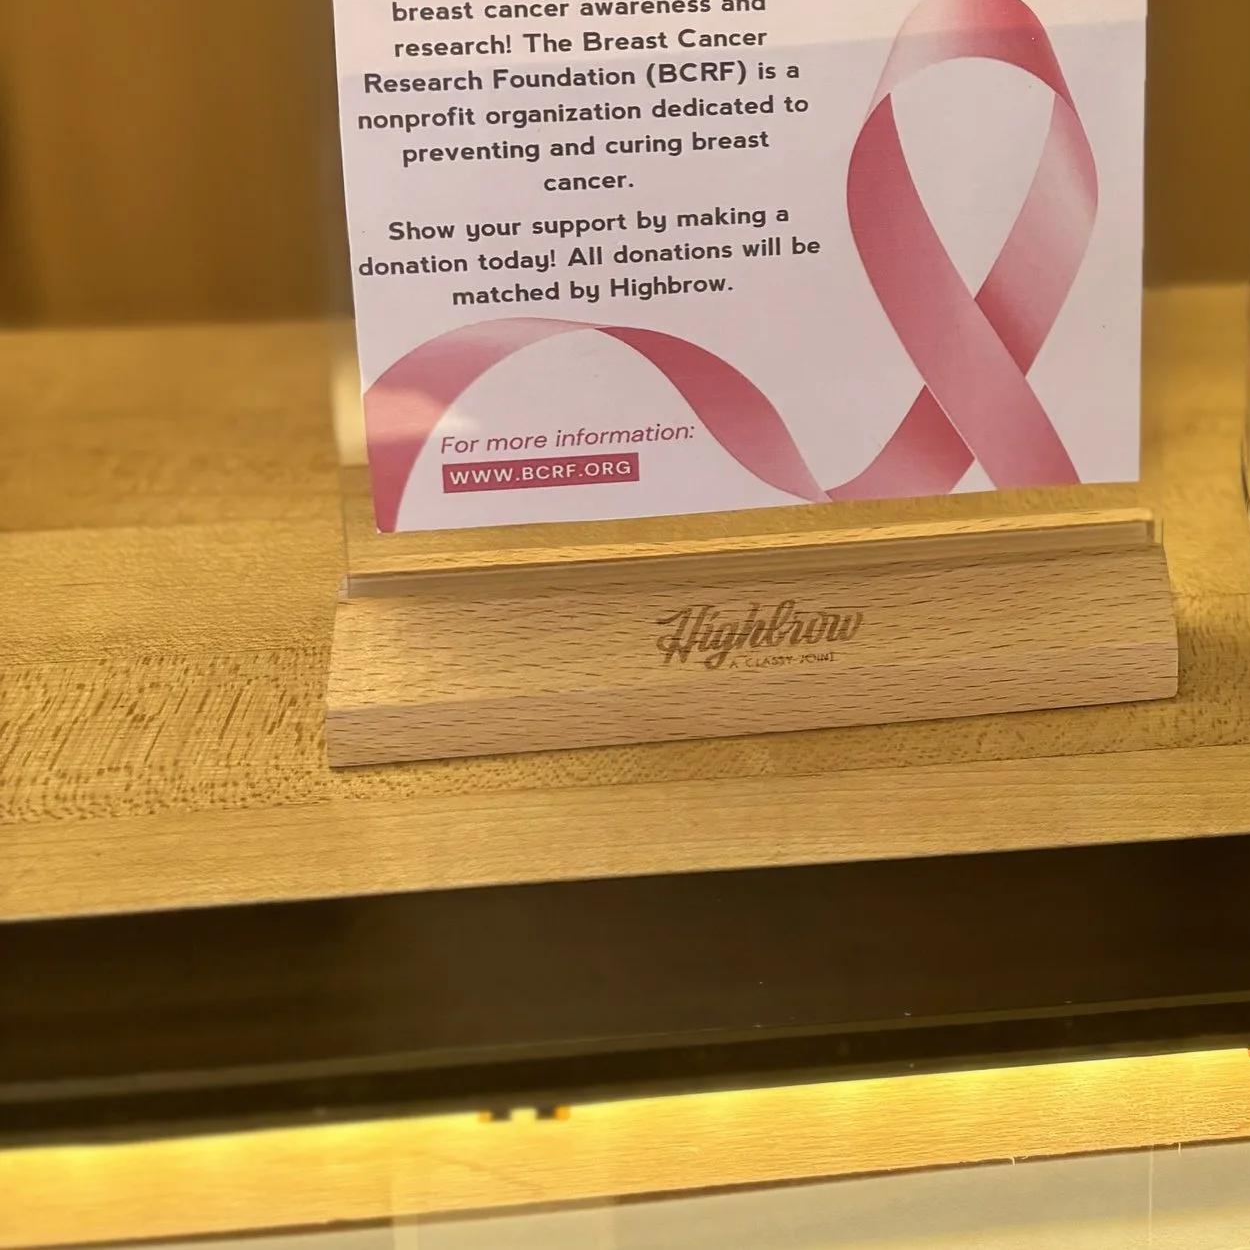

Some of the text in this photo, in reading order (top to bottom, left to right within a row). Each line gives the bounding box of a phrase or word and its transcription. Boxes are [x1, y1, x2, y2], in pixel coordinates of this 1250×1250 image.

[392, 2, 473, 21] breast
[485, 3, 569, 18] cancer
[395, 29, 767, 57] research! The Breast Cancer
[365, 60, 799, 93] Research Foundation (BCRF) is a
[359, 95, 808, 133] nonprofit organization dedicated to
[403, 131, 769, 167] preventing and curing breast
[544, 175, 633, 191] cancer.
[389, 207, 788, 242] Show your support by making a
[359, 236, 820, 276] donation today! All donations will be
[453, 275, 733, 305] matched by Highbrow.
[441, 424, 694, 454] For more information:
[450, 461, 630, 484] WWW.BCRF.ORG
[656, 600, 863, 669] Highbrow
[746, 656, 793, 668] CLASSY
